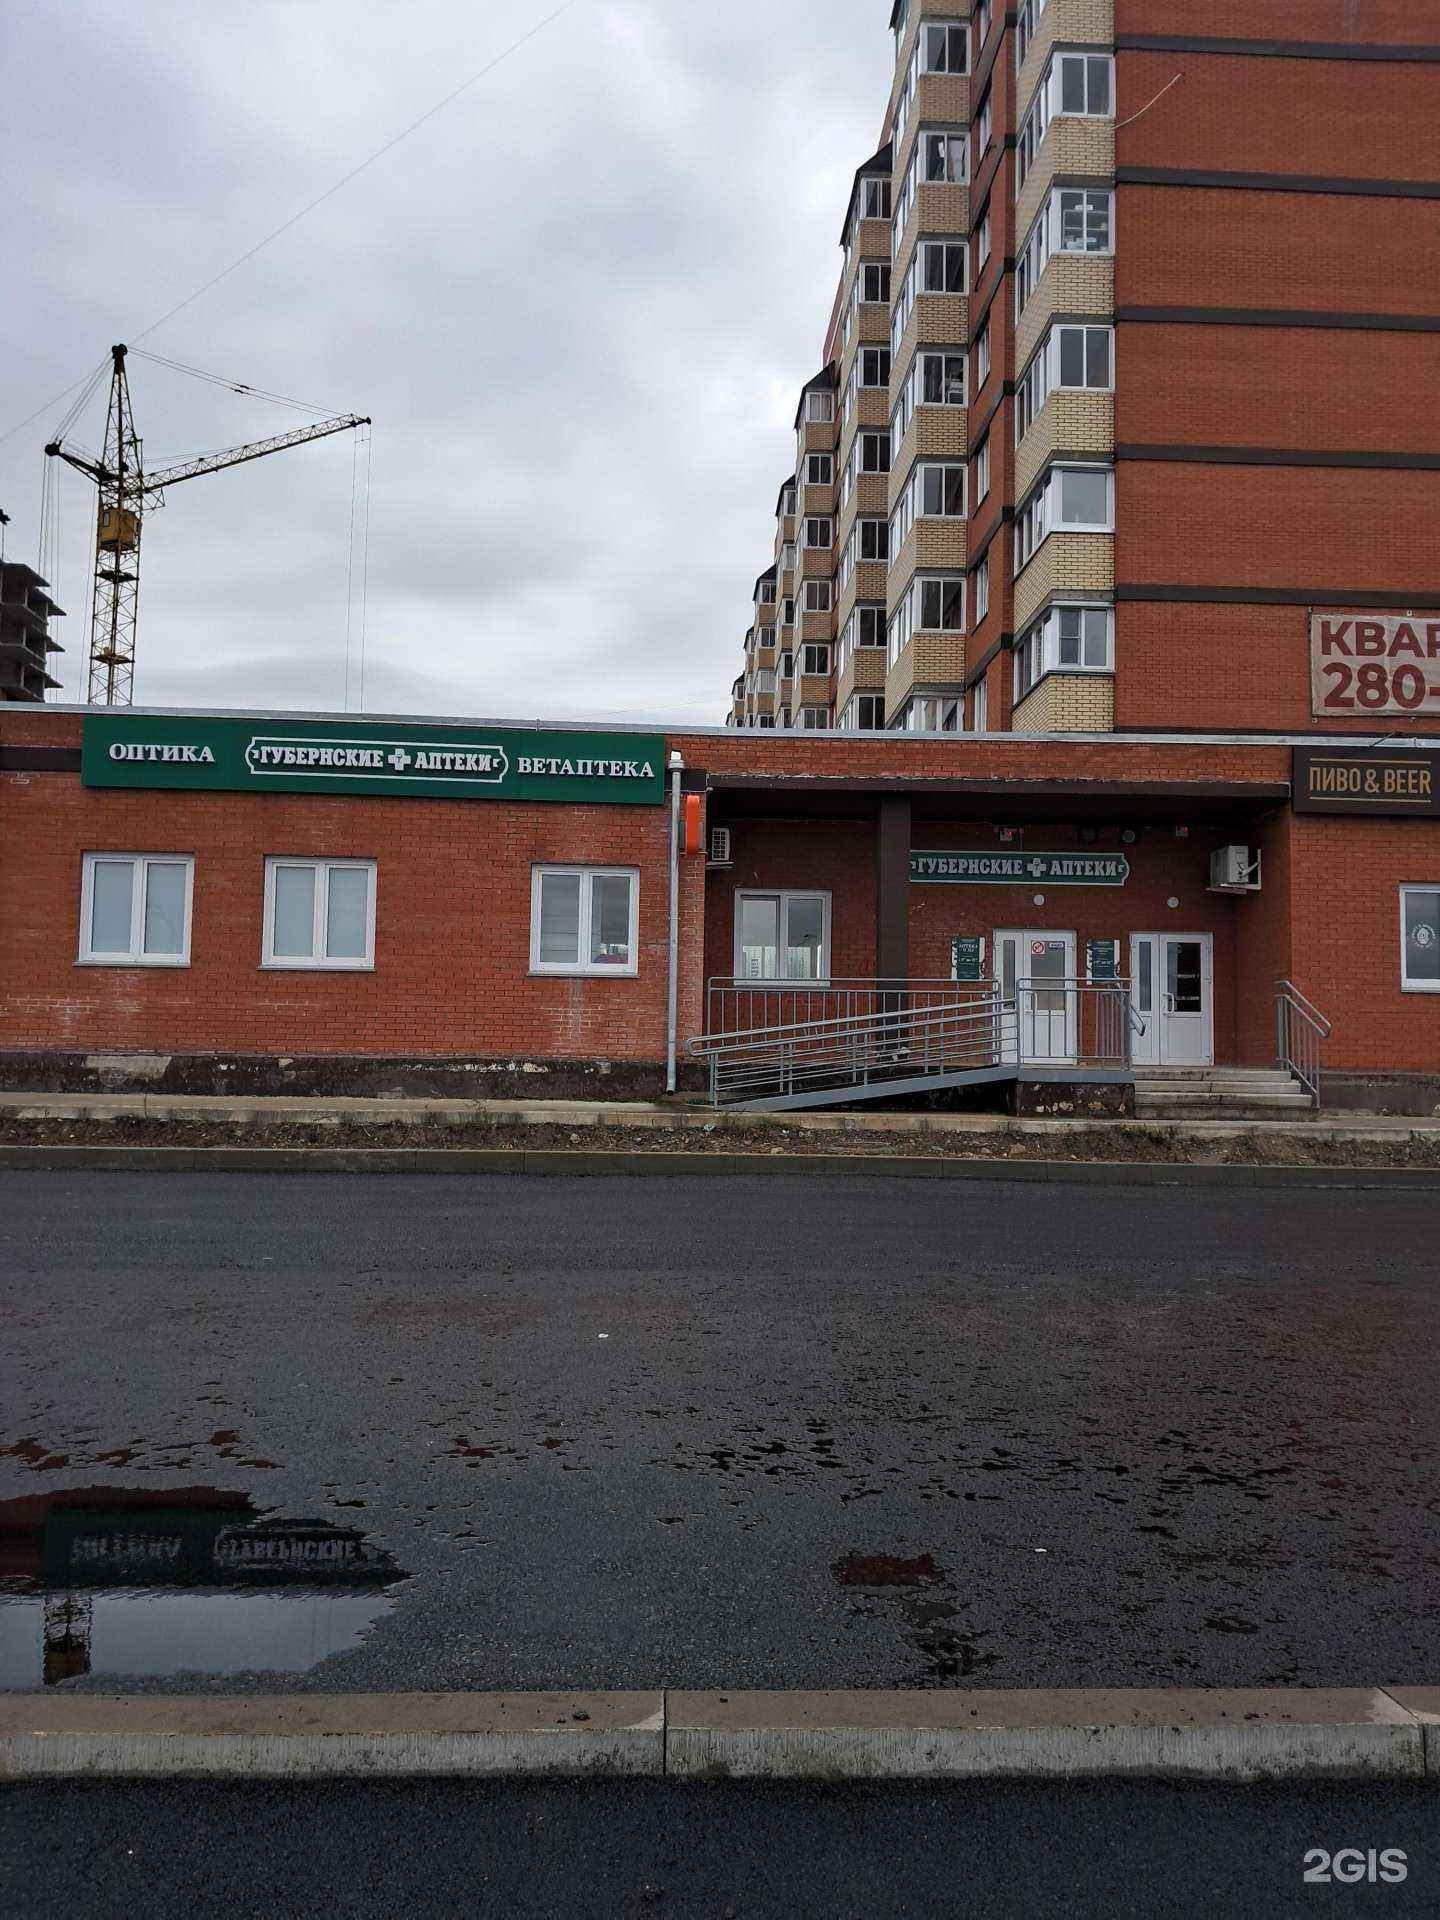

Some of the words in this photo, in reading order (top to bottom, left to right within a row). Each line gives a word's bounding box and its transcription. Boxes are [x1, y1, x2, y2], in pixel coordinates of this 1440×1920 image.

[108, 743, 215, 762] ОПТИКА
[259, 746, 384, 768] ГУБЕРНСКИЕ
[414, 751, 492, 772] АПТЕКИ
[517, 757, 655, 778] ВЕТАПТЕКА
[917, 856, 1023, 876] ГУБЕРНСКИЕ
[1050, 858, 1117, 877] АПТЕКИ
